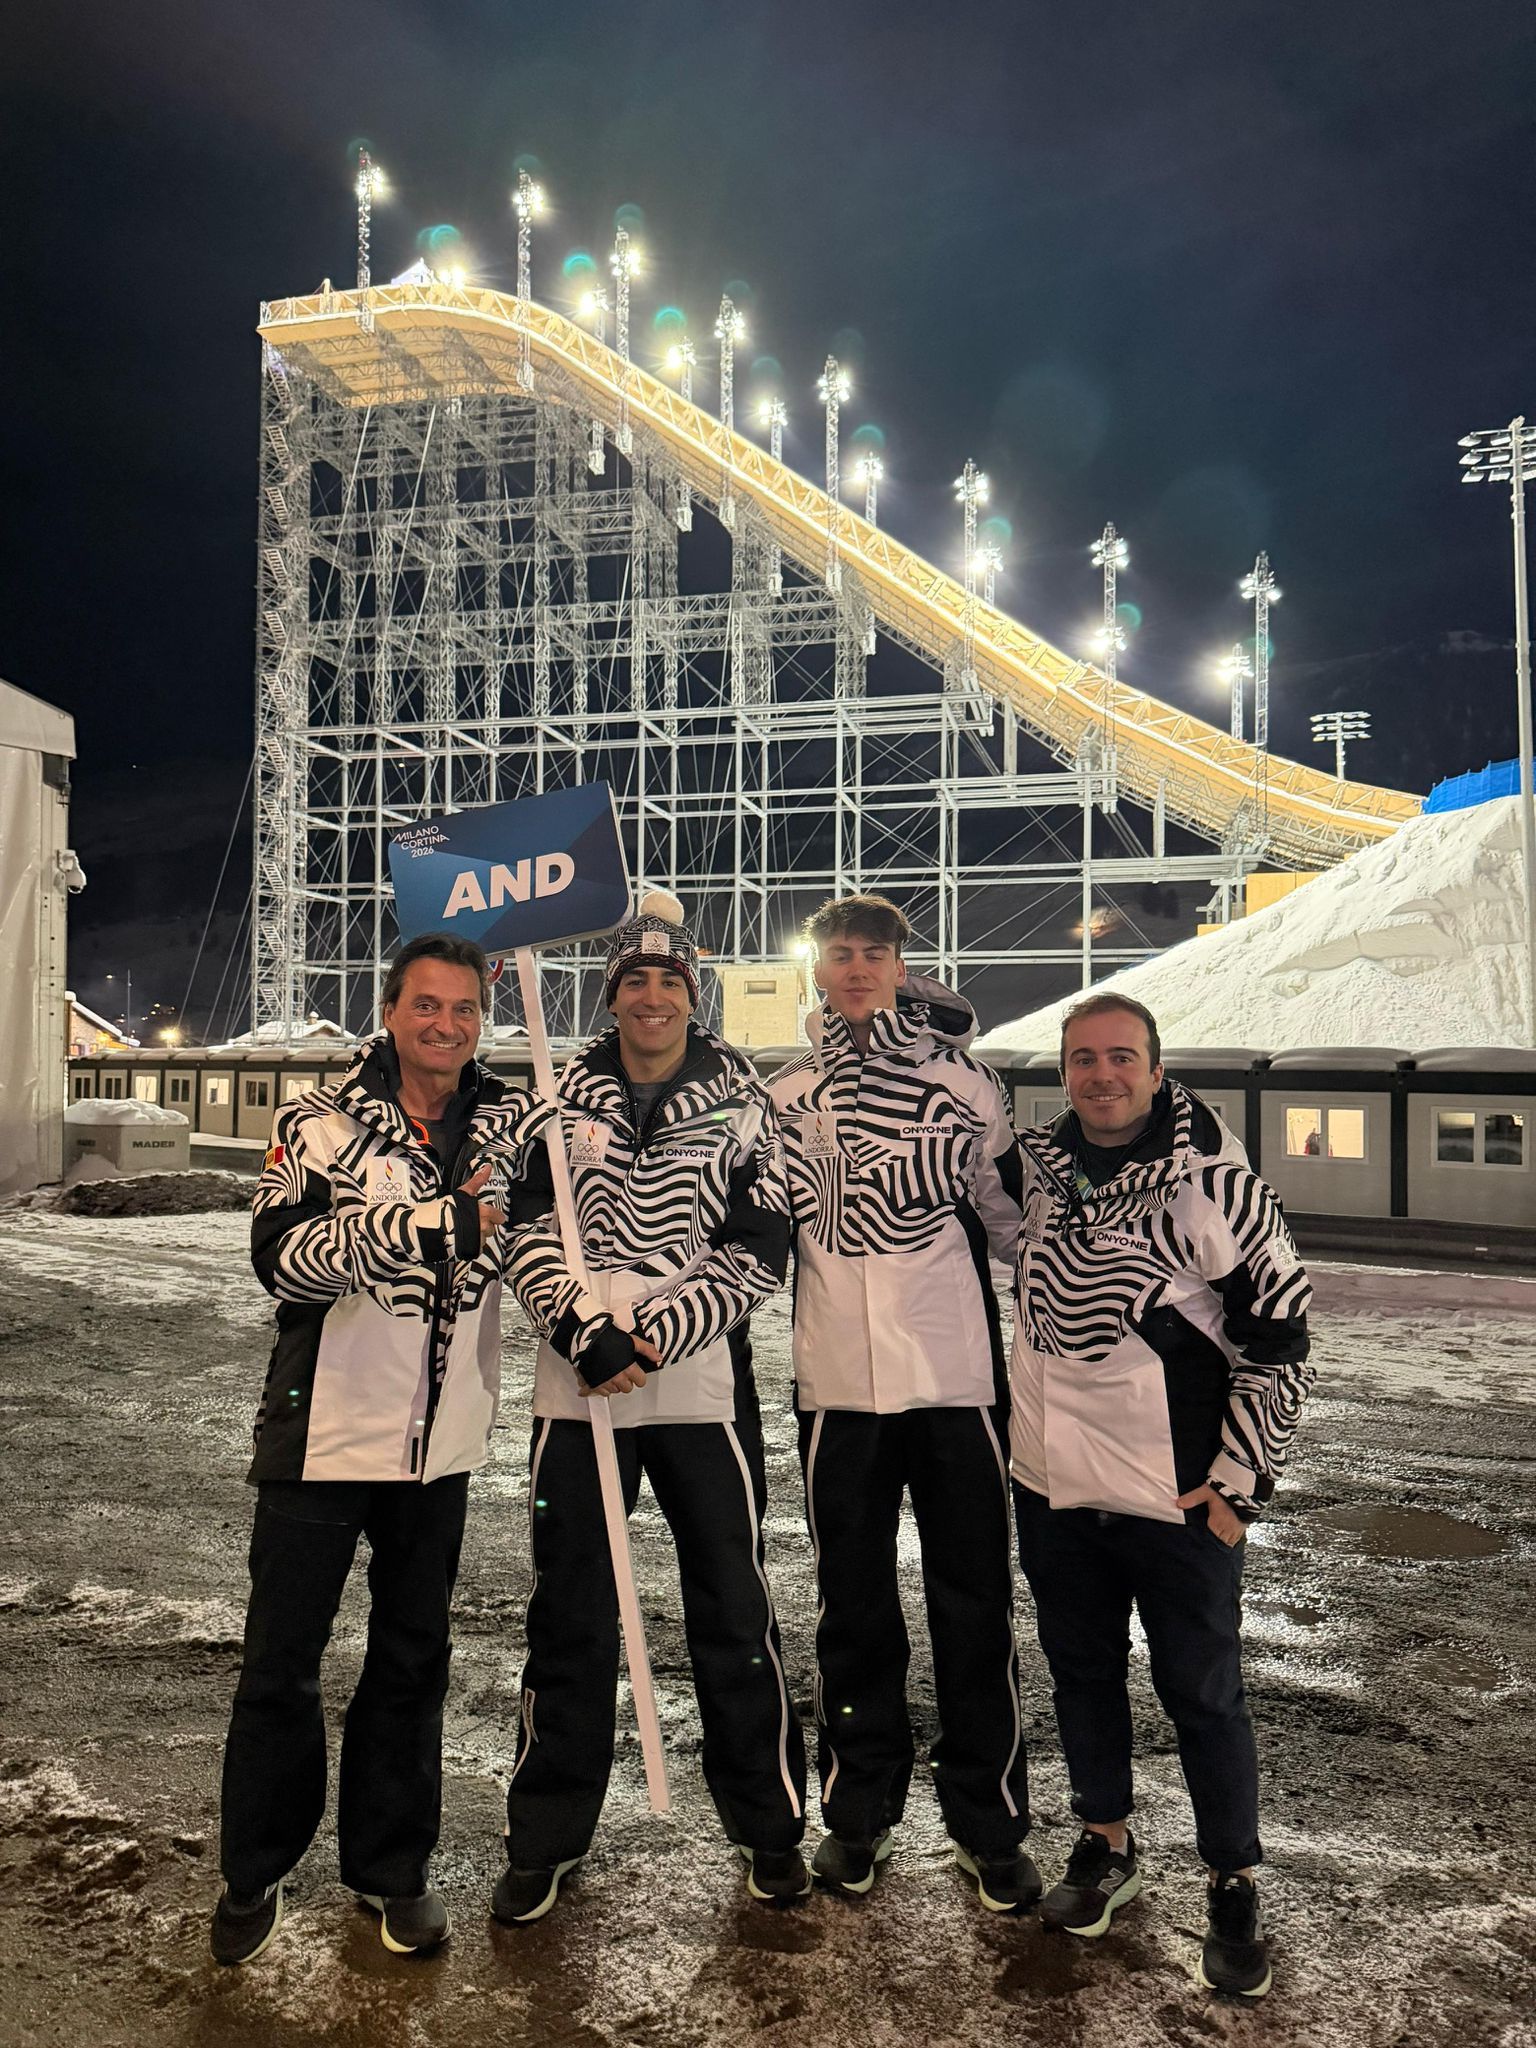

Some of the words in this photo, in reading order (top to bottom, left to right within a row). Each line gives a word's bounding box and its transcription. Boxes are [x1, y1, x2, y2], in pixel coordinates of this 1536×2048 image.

[391, 825, 439, 843] MILANO
[400, 834, 451, 851] CORTINA
[411, 846, 435, 859] 2026
[442, 852, 575, 919] AND
[572, 1154, 602, 1164] ANDORRA
[369, 1194, 409, 1202] ANDORRA
